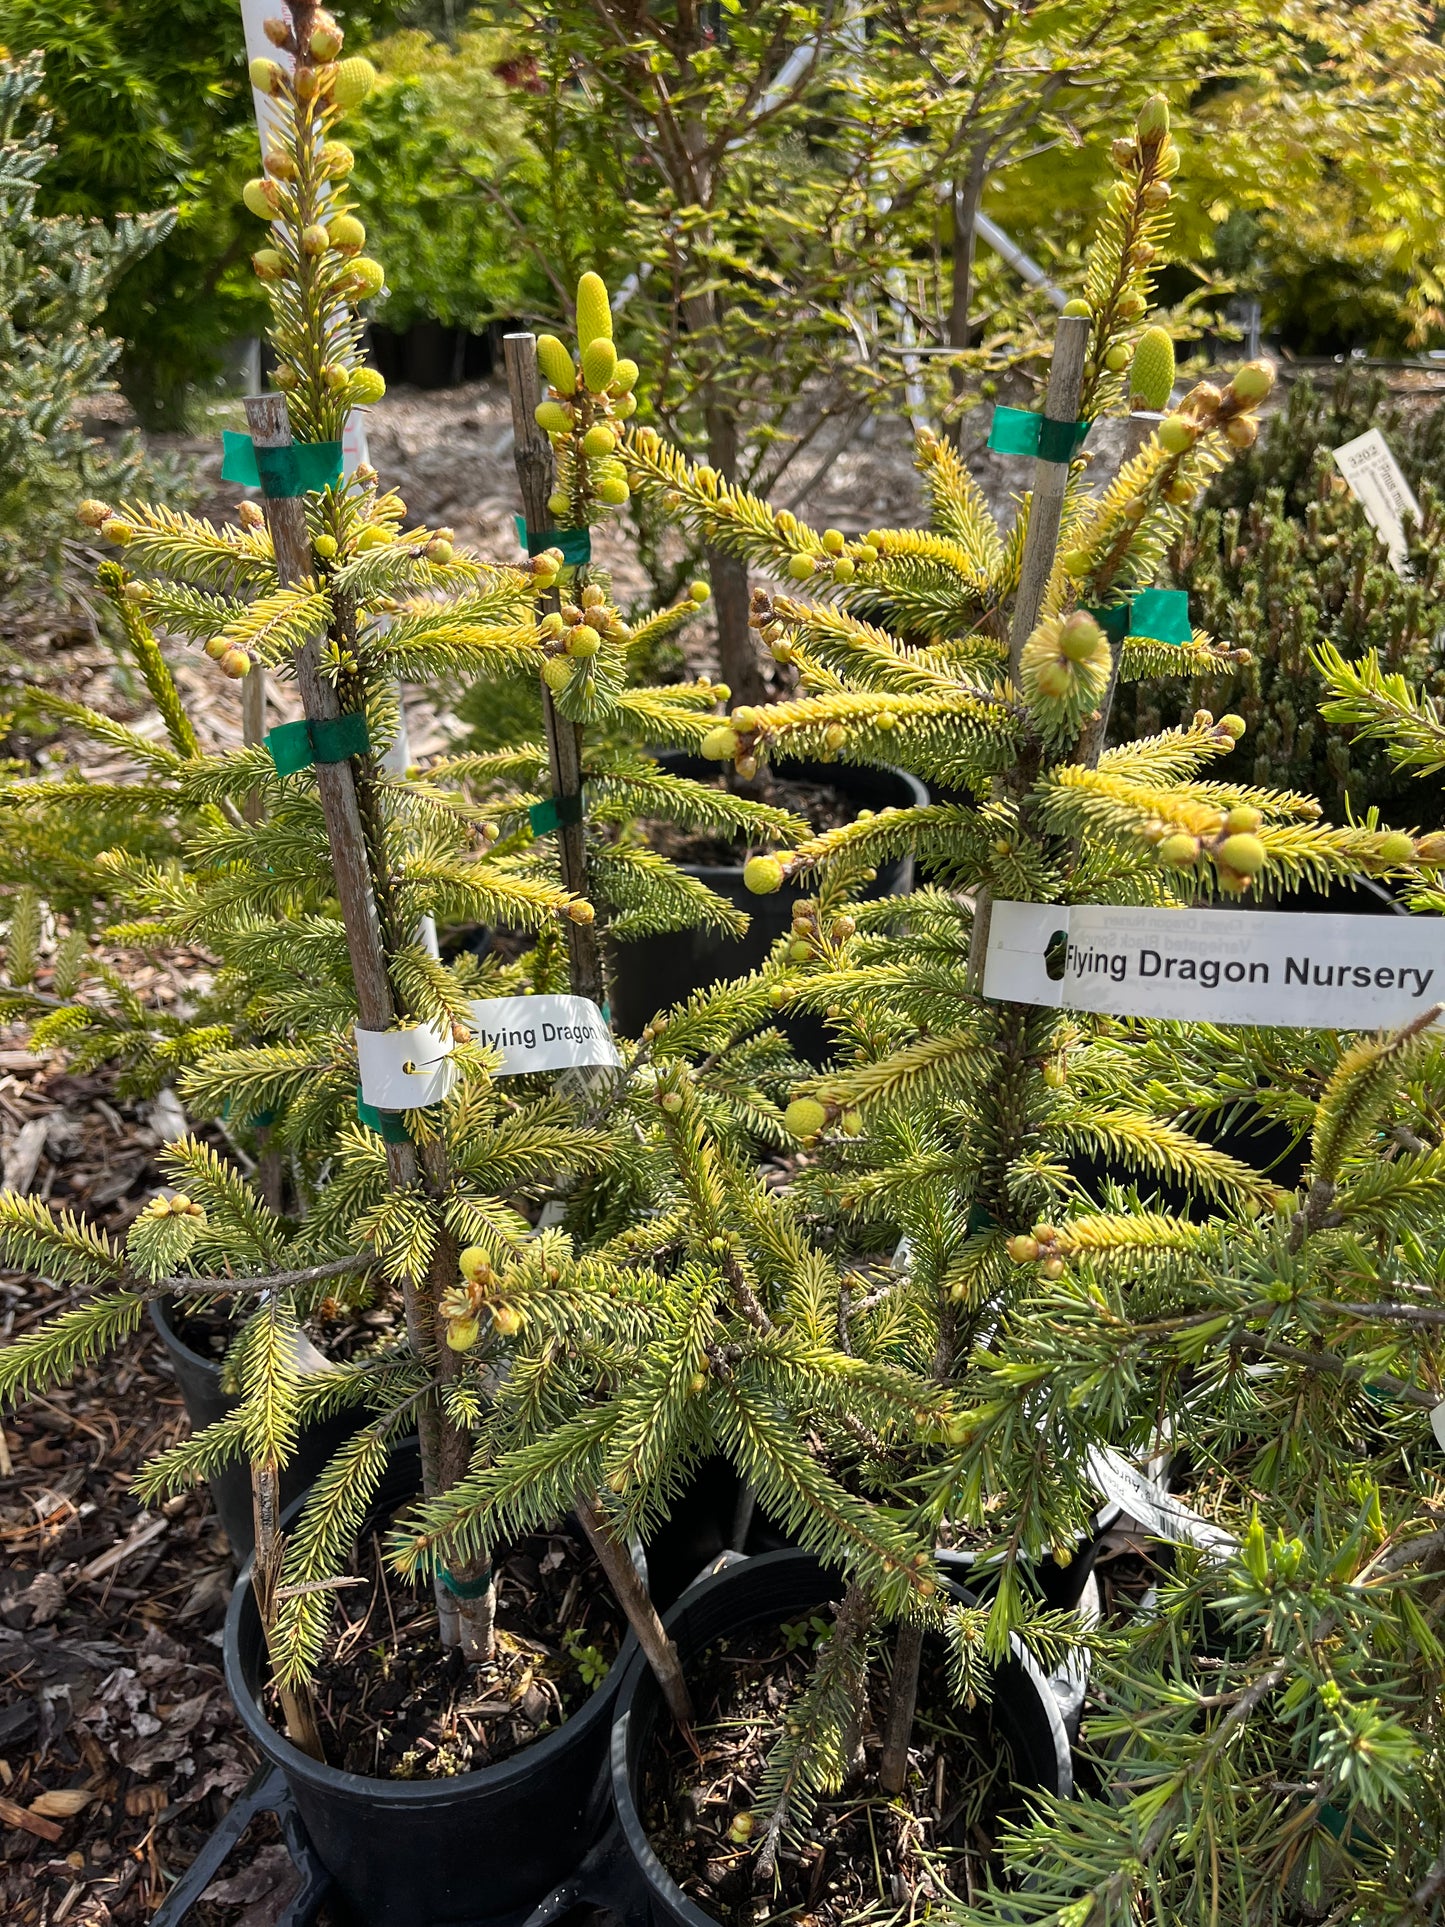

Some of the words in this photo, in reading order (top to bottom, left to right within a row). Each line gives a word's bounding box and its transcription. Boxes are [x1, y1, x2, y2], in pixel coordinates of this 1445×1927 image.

[1066, 945, 1127, 982] Flying
[1138, 949, 1269, 989] Dragon
[1284, 956, 1435, 998] Nursery
[541, 1022, 598, 1044] Dragon
